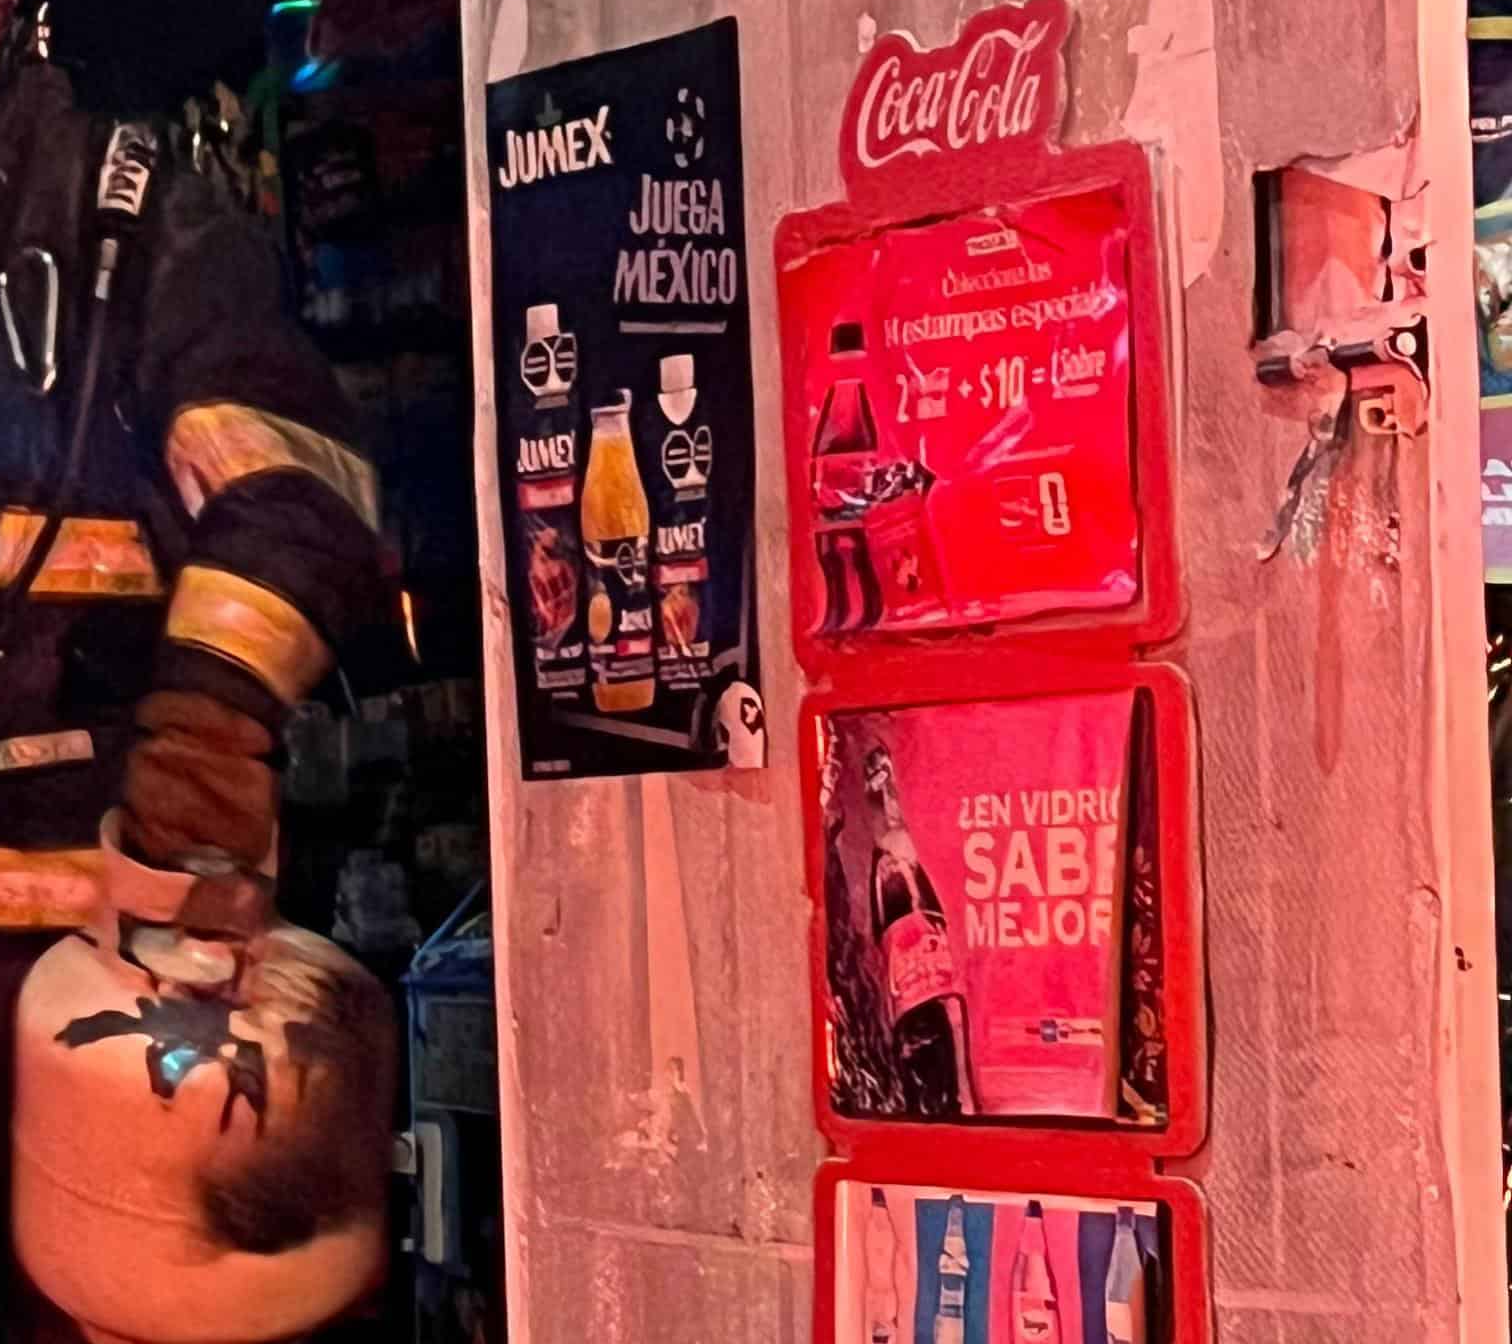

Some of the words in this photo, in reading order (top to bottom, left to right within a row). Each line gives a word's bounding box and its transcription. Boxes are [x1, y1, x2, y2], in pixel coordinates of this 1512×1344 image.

[856, 20, 1051, 168] Coca-Cola
[498, 105, 614, 188] JUMEX
[629, 173, 725, 235] JUEGA
[979, 356, 1025, 409] $10
